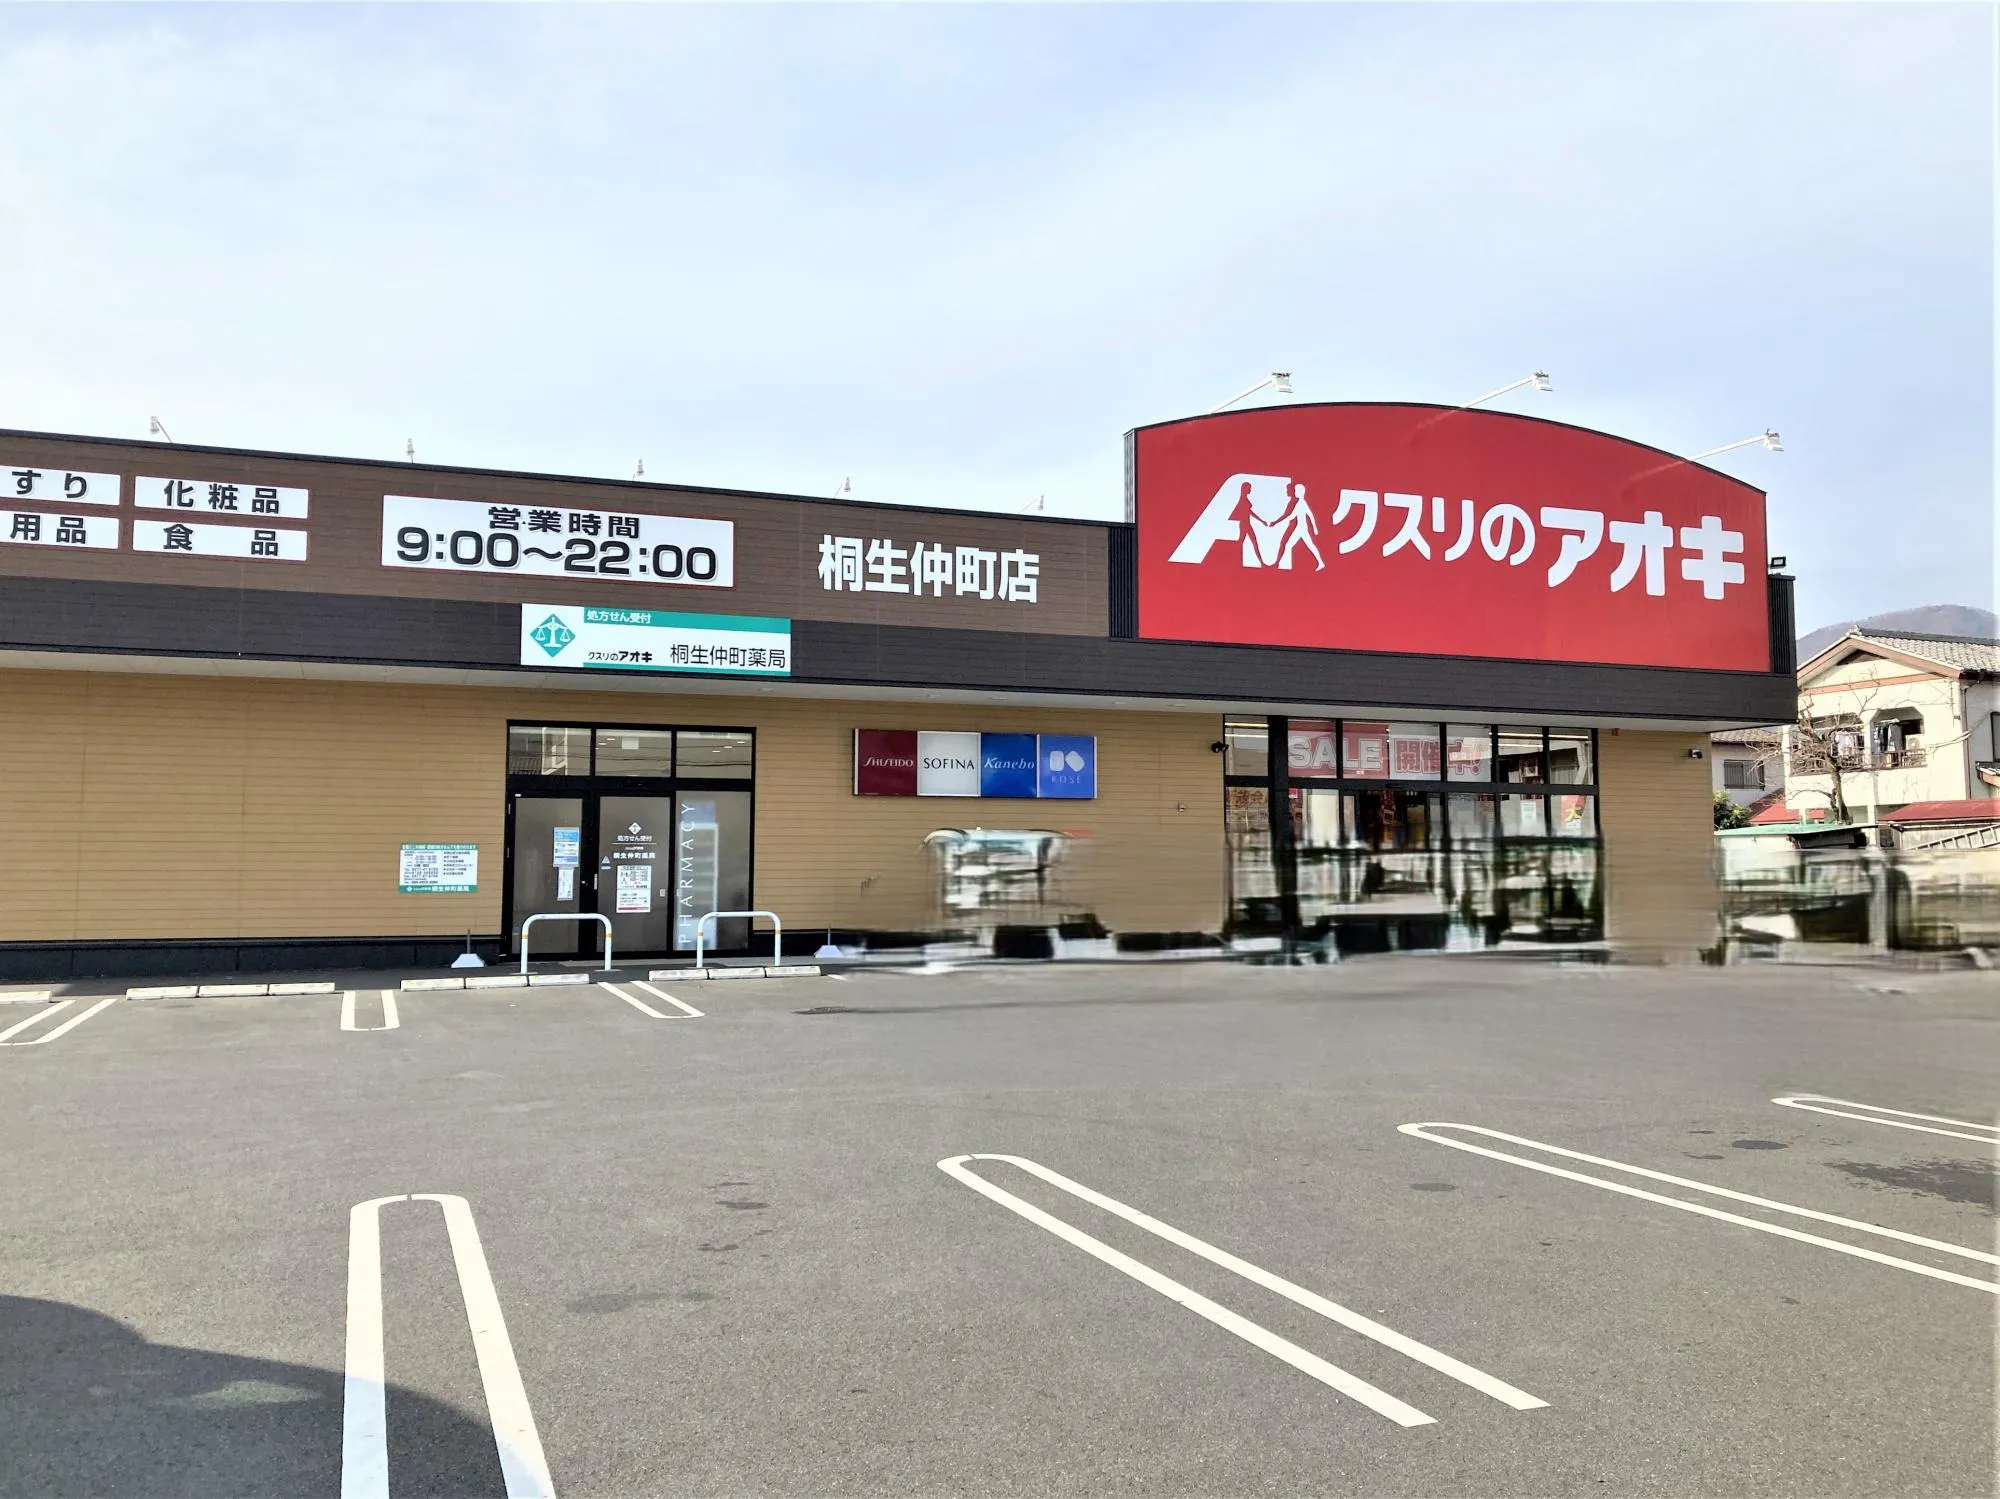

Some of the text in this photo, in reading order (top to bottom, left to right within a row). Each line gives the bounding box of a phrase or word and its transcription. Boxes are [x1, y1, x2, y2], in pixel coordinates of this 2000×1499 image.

[163, 479, 280, 514] 化粧品
[488, 506, 640, 539] 営業時間
[162, 523, 279, 557] 食品
[1331, 488, 1745, 600] クスリのアオキ
[818, 534, 1040, 603] 桐生仲町店
[587, 610, 652, 625] 処方せん受付
[588, 643, 787, 669] クスリのアオキ 桐生仲町薬局
[863, 756, 914, 768] SHISEIDO
[923, 756, 975, 770] SOFINA
[983, 756, 1036, 770] Kanebo
[1287, 735, 1383, 770] SALE
[678, 803, 697, 944] PHARMACY
